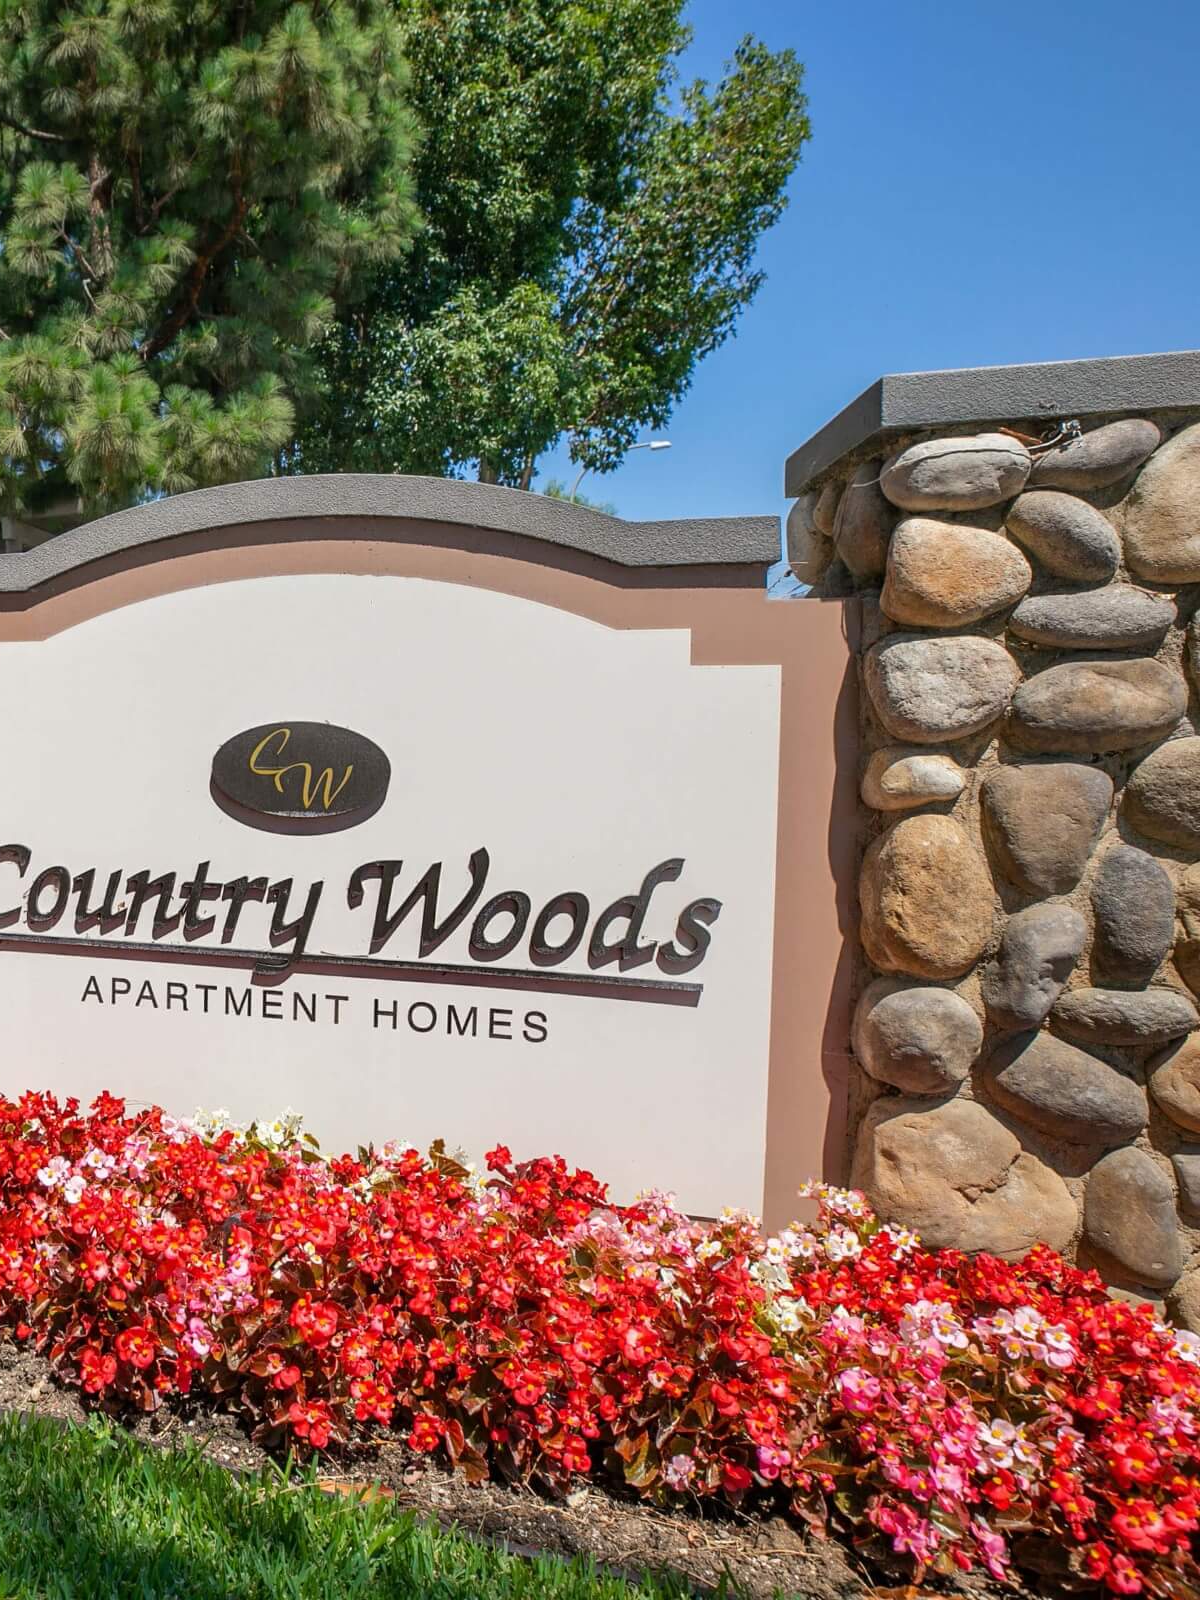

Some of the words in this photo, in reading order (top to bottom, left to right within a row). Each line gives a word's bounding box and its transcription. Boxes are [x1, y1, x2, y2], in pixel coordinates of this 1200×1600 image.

[347, 847, 722, 974] Woods
[81, 975, 349, 1025] APARTMENT
[373, 998, 548, 1043] HOMES
